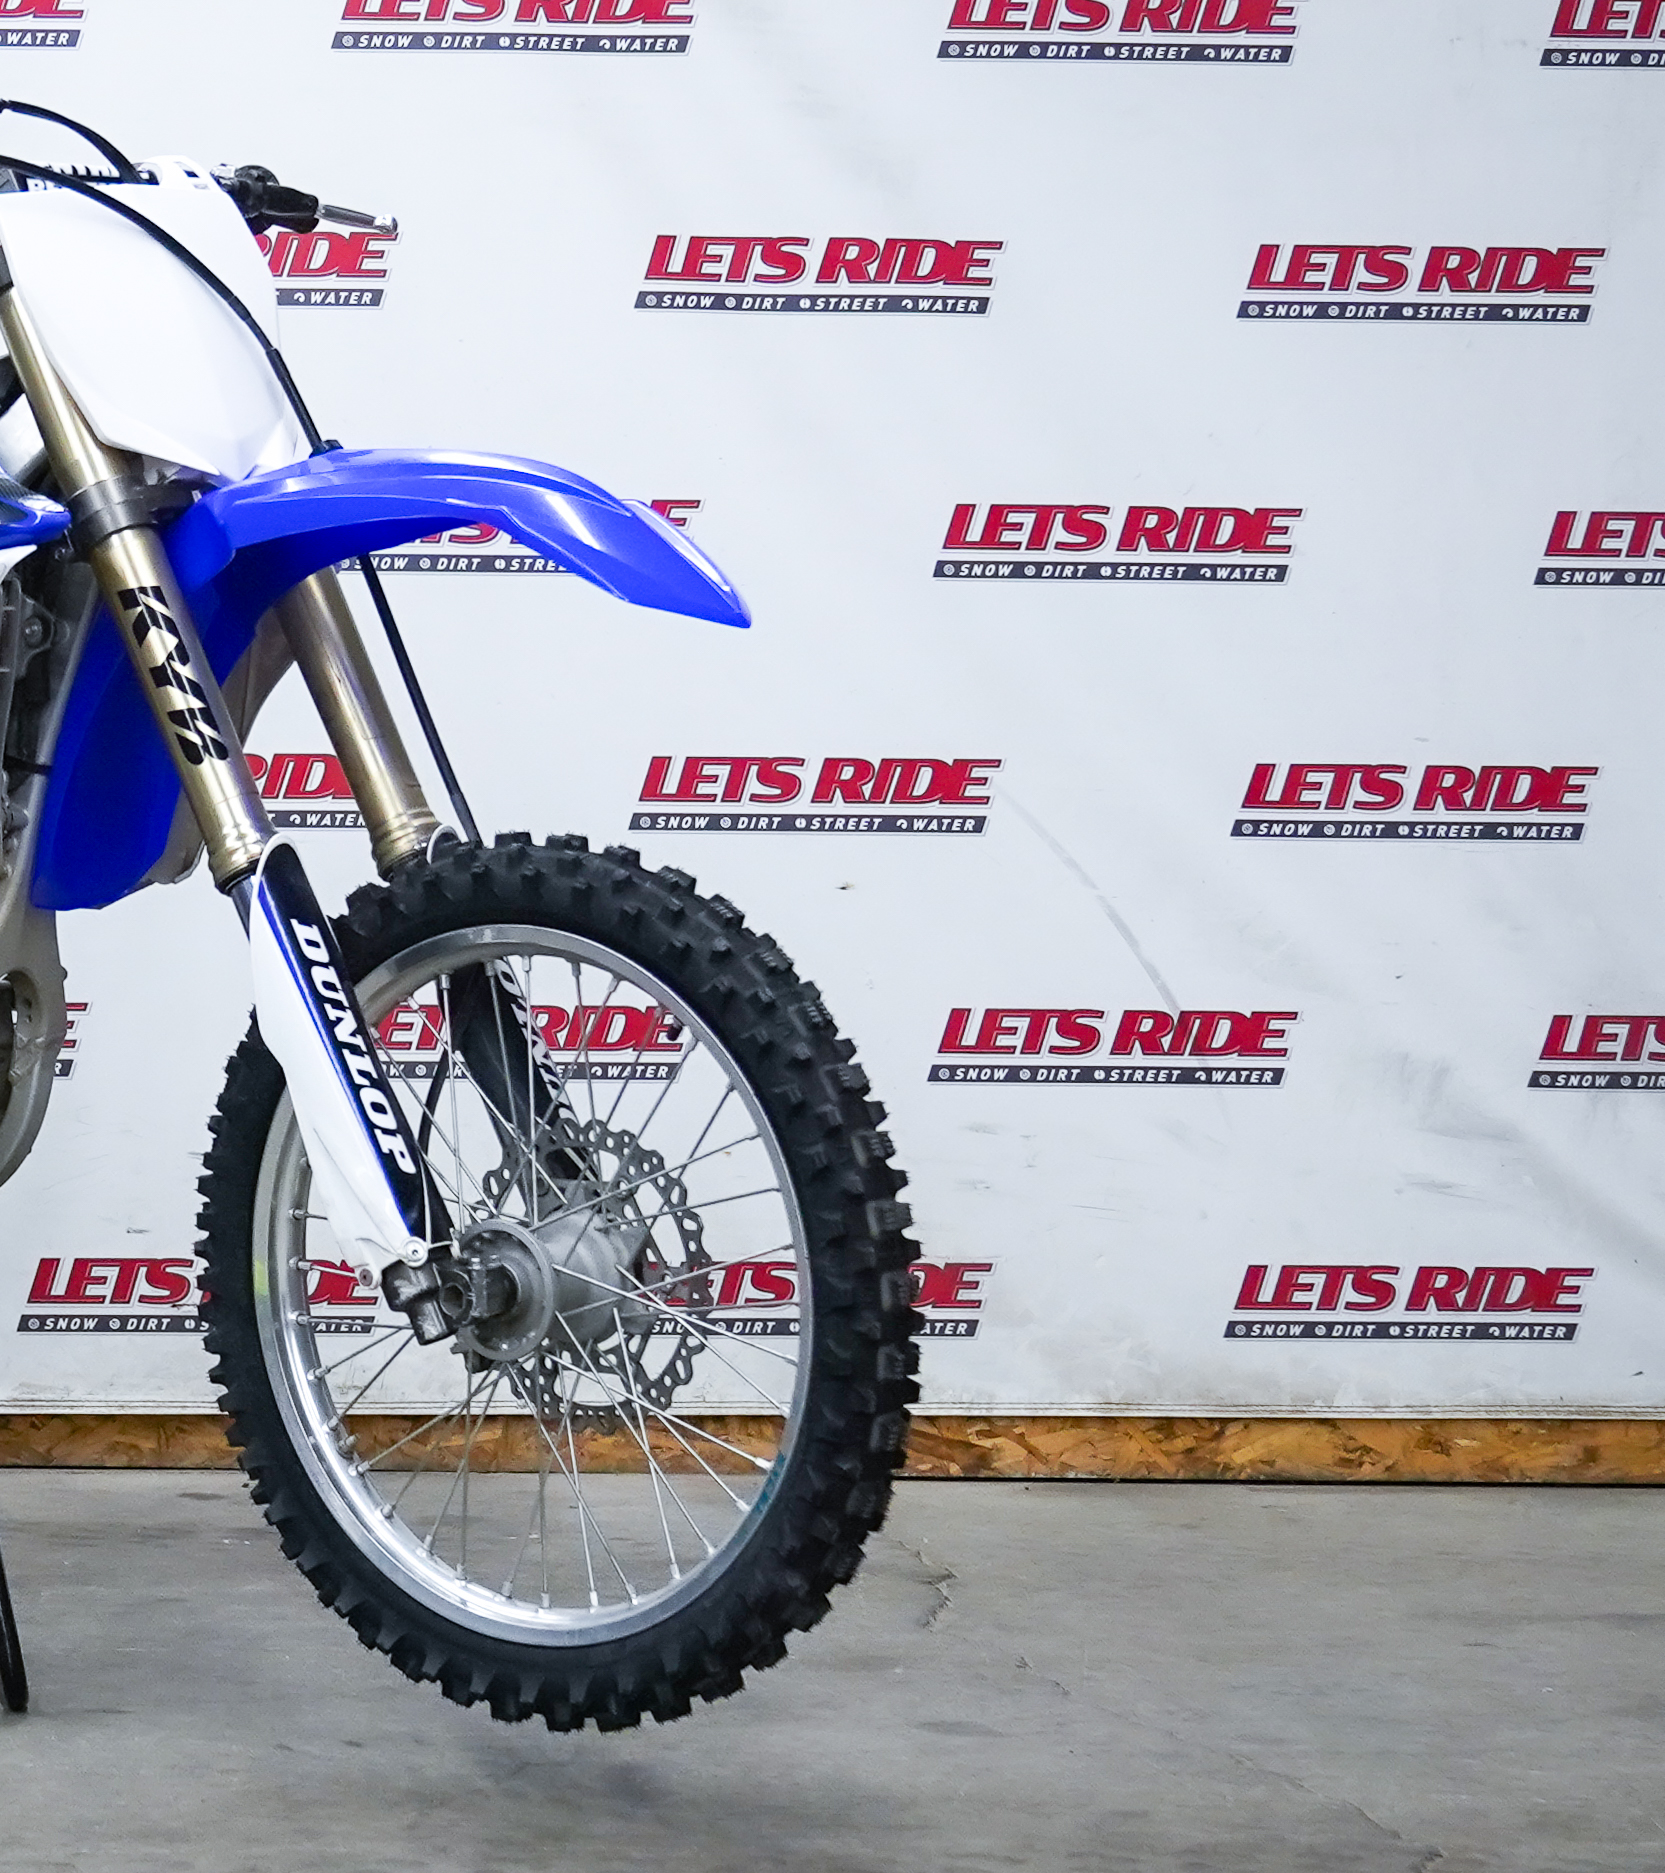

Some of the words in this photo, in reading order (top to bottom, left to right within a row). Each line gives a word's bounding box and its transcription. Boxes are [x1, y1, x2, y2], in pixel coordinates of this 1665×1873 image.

[1549, 0, 1665, 38] LET
[7, 33, 70, 46] WATER
[358, 34, 412, 47] SNOW
[440, 35, 485, 48] DIRT
[513, 36, 586, 50] STREET
[616, 38, 680, 52] WATER
[964, 43, 1018, 57] SNOW
[1046, 44, 1090, 58] DIRT
[1118, 46, 1190, 60] STREET
[1220, 48, 1283, 61] WATER
[1566, 52, 1620, 64] SNOW
[644, 235, 810, 283] LETS
[816, 238, 1004, 286] RIDE
[1247, 244, 1412, 291] LETS
[1418, 247, 1605, 294] RIDE
[310, 292, 372, 304] WATER
[660, 294, 714, 308] SNOW
[742, 296, 786, 309] DIRT
[814, 297, 887, 311] STREET
[917, 299, 980, 313] WATER
[1263, 304, 1317, 317] SNOW
[1345, 305, 1388, 318] DIRT
[1416, 306, 1488, 320] STREET
[1518, 308, 1581, 321] WATER
[943, 503, 1110, 551] LETS
[1115, 506, 1304, 554] RIDE
[1543, 511, 1665, 558] LET
[436, 558, 481, 570] DIRT
[510, 559, 566, 572] STRE
[960, 563, 1014, 576] SNOW
[1042, 564, 1086, 578] DIRT
[1114, 565, 1186, 579] STREET
[1216, 567, 1279, 581] WATER
[1560, 571, 1614, 583] SNOW
[118, 586, 229, 766] KYB
[638, 756, 806, 803] LETS
[811, 758, 1001, 805] RIDE
[1243, 763, 1407, 810] LETS
[1413, 766, 1599, 812] RIDE
[655, 816, 709, 829] SNOW
[737, 816, 782, 830] DIRT
[810, 817, 883, 831] STREET
[913, 819, 976, 832] WATER
[1259, 823, 1312, 836] SNOW
[1340, 824, 1384, 837] DIRT
[1411, 824, 1483, 838] STREET
[1513, 826, 1575, 839] WATER
[938, 1008, 1105, 1055] LETS
[1110, 1010, 1300, 1057] RIDE
[290, 918, 418, 1175] DUNLOP
[954, 1067, 1008, 1080] SNOW
[1036, 1068, 1080, 1081] DIRT
[1108, 1069, 1181, 1083] STREET
[1211, 1071, 1275, 1084] WATER
[1554, 1074, 1610, 1086] SNOW
[1637, 1076, 1665, 1088] DIR
[26, 1258, 194, 1304] LETS
[907, 1262, 994, 1308] DE
[1234, 1265, 1400, 1311] LETS
[1405, 1267, 1593, 1312] RIDE
[44, 1318, 99, 1330] SNOW
[127, 1318, 171, 1330] DIRT
[732, 1322, 776, 1334] DIRT
[920, 1322, 968, 1335] ATER
[1250, 1323, 1304, 1336] SNOW
[1331, 1324, 1375, 1337] DIRT
[1403, 1325, 1475, 1338] STREET
[1505, 1326, 1568, 1339] WATER
